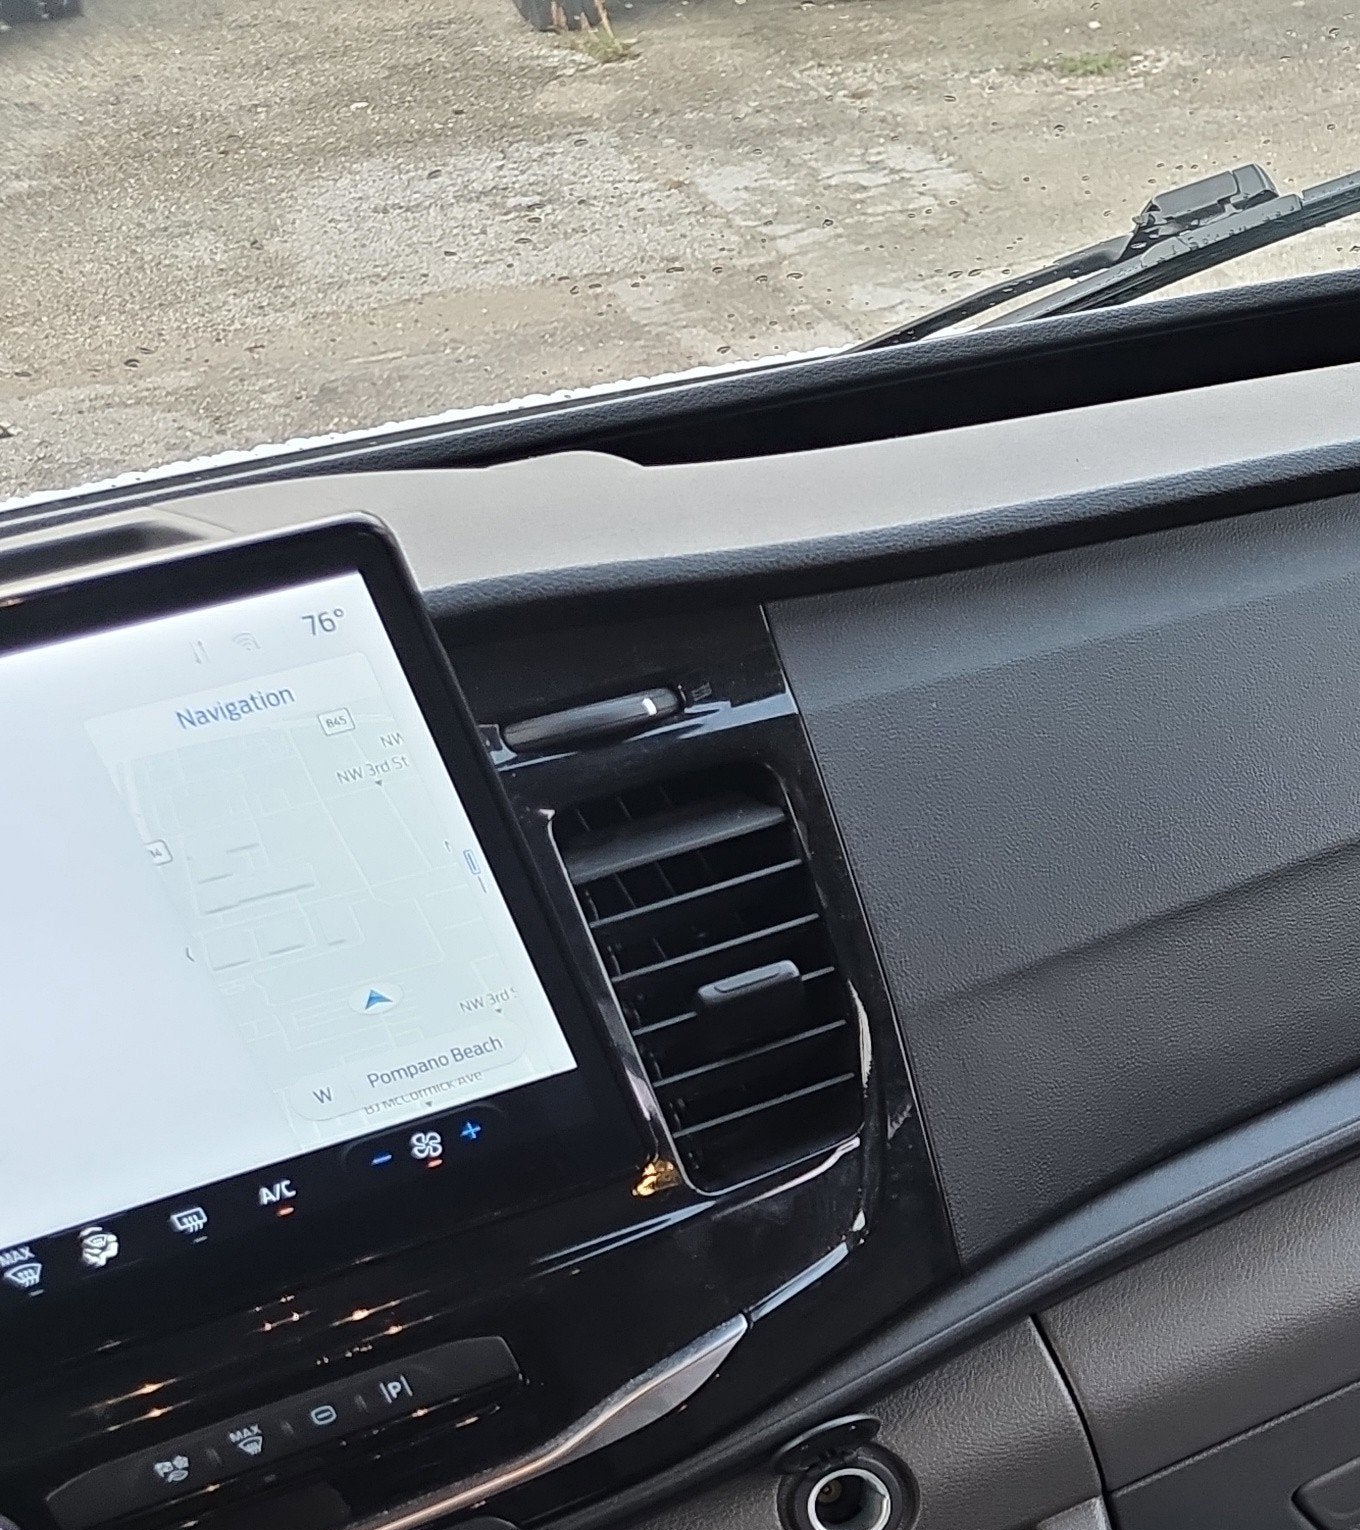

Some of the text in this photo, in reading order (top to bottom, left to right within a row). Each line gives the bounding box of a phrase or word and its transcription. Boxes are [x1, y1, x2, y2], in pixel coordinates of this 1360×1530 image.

[302, 607, 345, 638] 76°
[175, 687, 295, 731] Navigation
[336, 755, 410, 785] NW 3rd St
[459, 997, 485, 1013] NW
[488, 989, 511, 1006] 3rd
[366, 1036, 504, 1089] Pompano Beach
[313, 1087, 333, 1104] W
[258, 1179, 297, 1205] A/C
[0, 1246, 35, 1267] MAX
[229, 1424, 262, 1443] MAX
